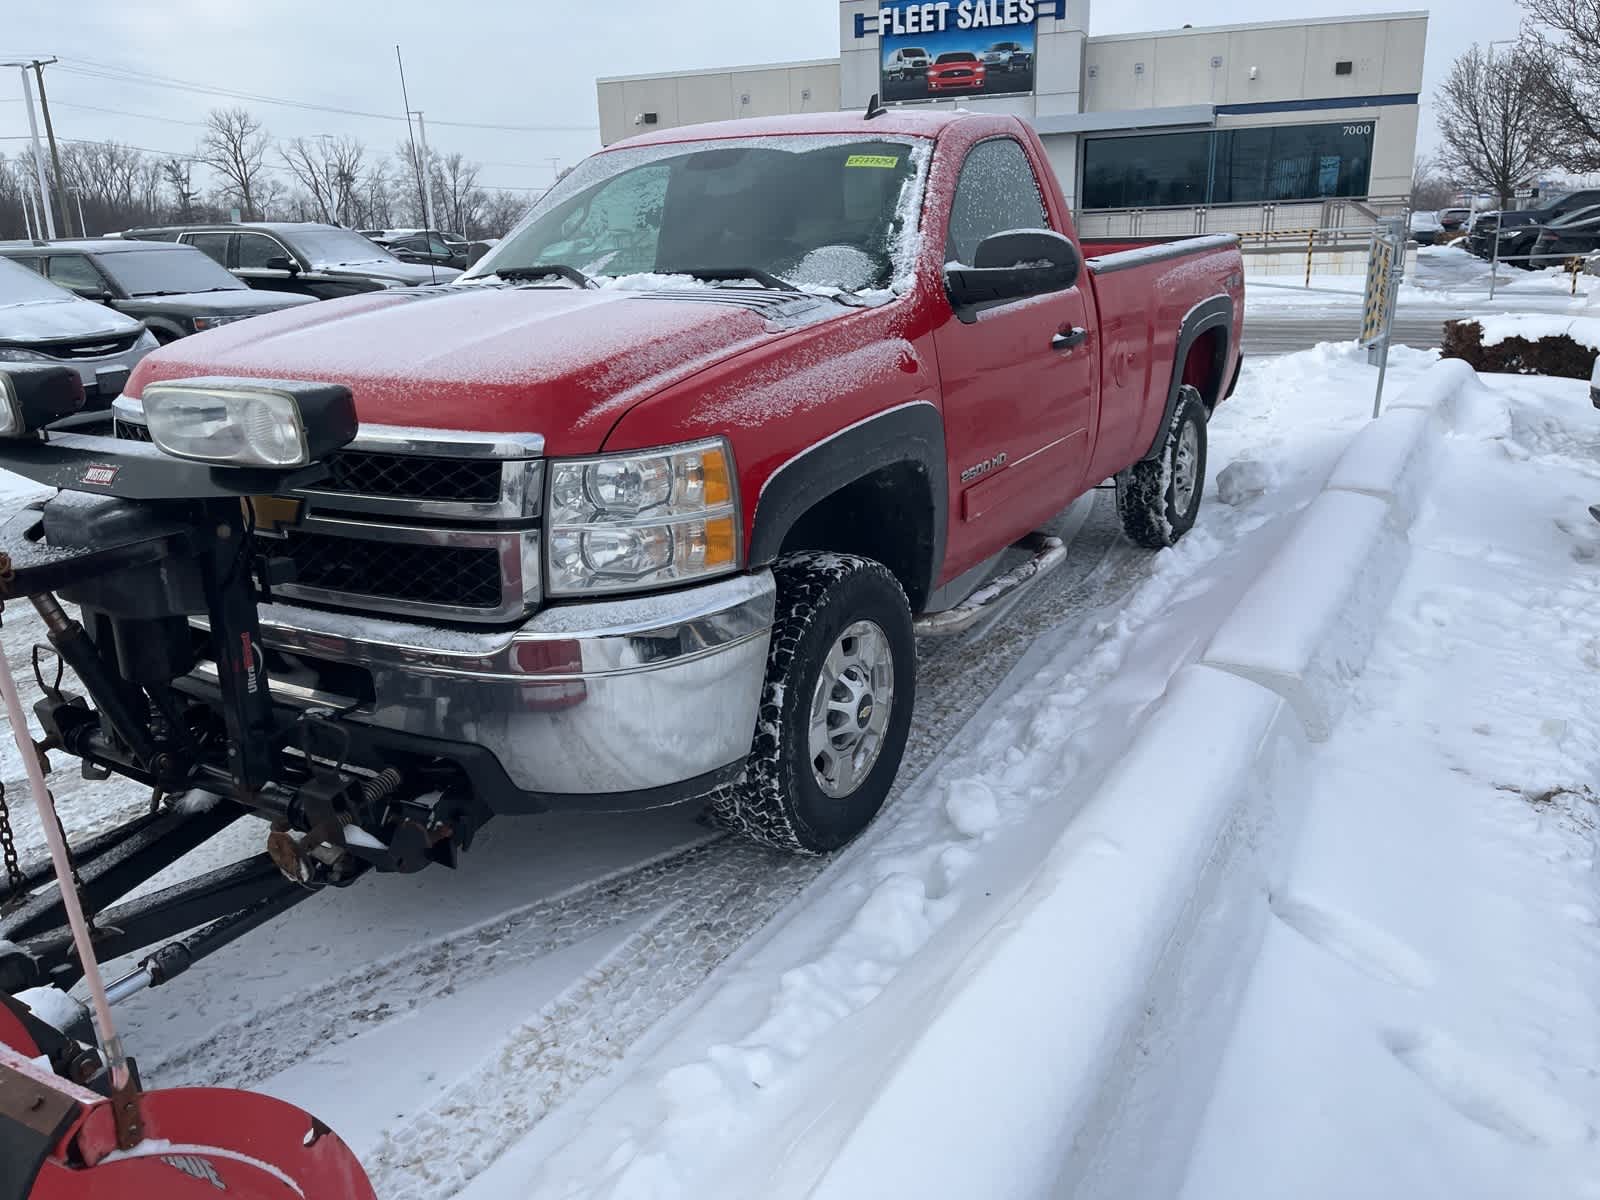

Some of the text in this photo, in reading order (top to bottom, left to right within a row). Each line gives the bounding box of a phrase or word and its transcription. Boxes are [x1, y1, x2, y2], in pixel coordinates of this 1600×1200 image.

[879, 0, 1035, 36] FLEET SALES
[1343, 125, 1370, 136] 7000
[960, 452, 1007, 482] 2500 HD
